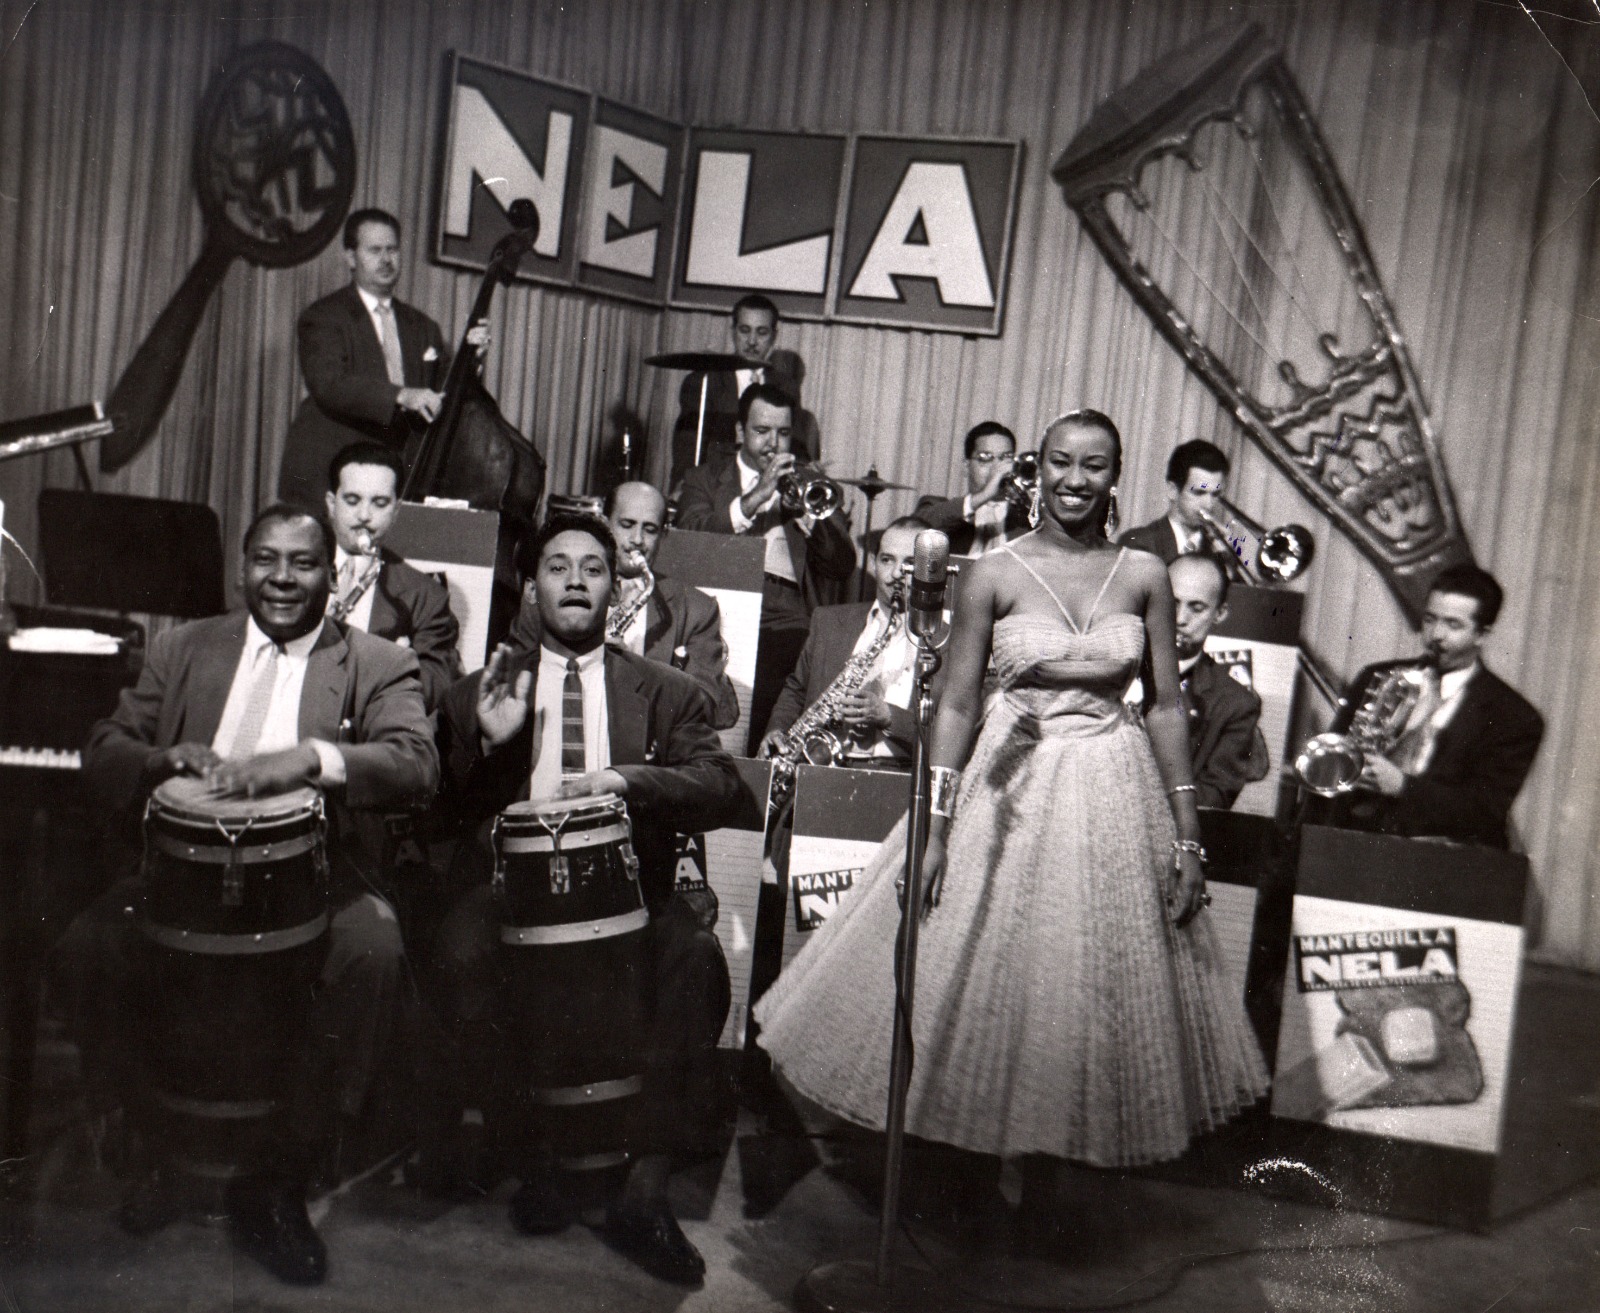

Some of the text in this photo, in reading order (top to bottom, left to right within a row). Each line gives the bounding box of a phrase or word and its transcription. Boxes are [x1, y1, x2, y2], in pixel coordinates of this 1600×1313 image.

[444, 84, 995, 307] NELA
[1300, 929, 1450, 952] MANTEQUILLA
[1301, 948, 1456, 984] NELA
